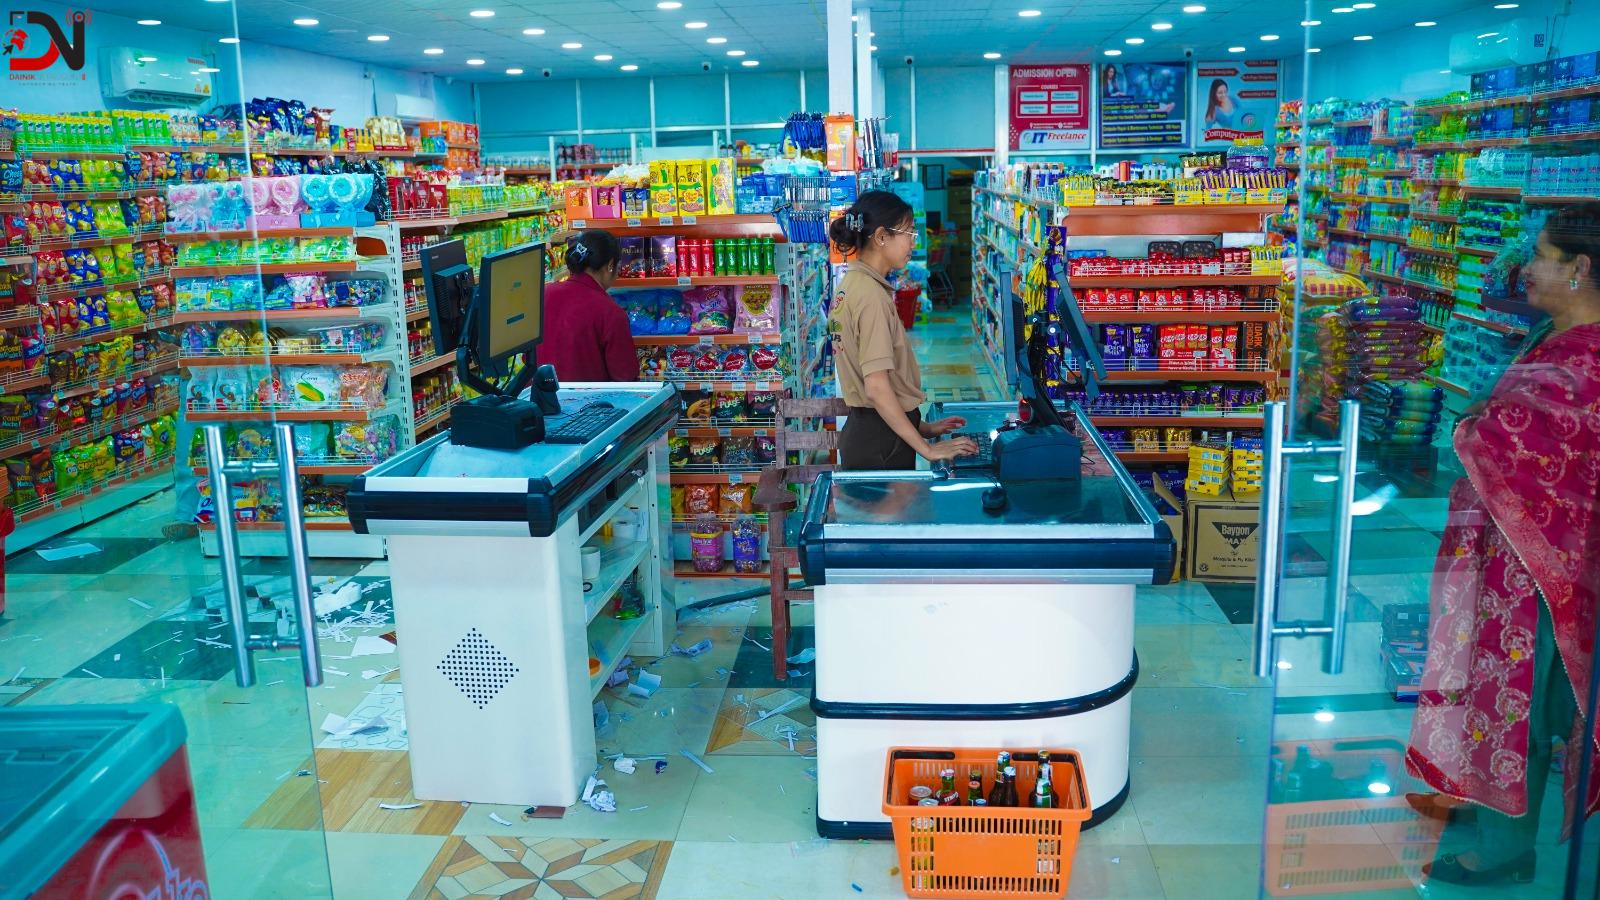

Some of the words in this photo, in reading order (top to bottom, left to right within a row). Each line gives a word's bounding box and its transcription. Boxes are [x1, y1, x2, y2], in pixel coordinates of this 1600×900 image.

[1013, 68, 1054, 78] ADMISSION
[1055, 68, 1077, 77] OPEN
[1032, 132, 1048, 144] IT
[1205, 130, 1239, 139] Computer
[1221, 524, 1250, 537] Baygon
